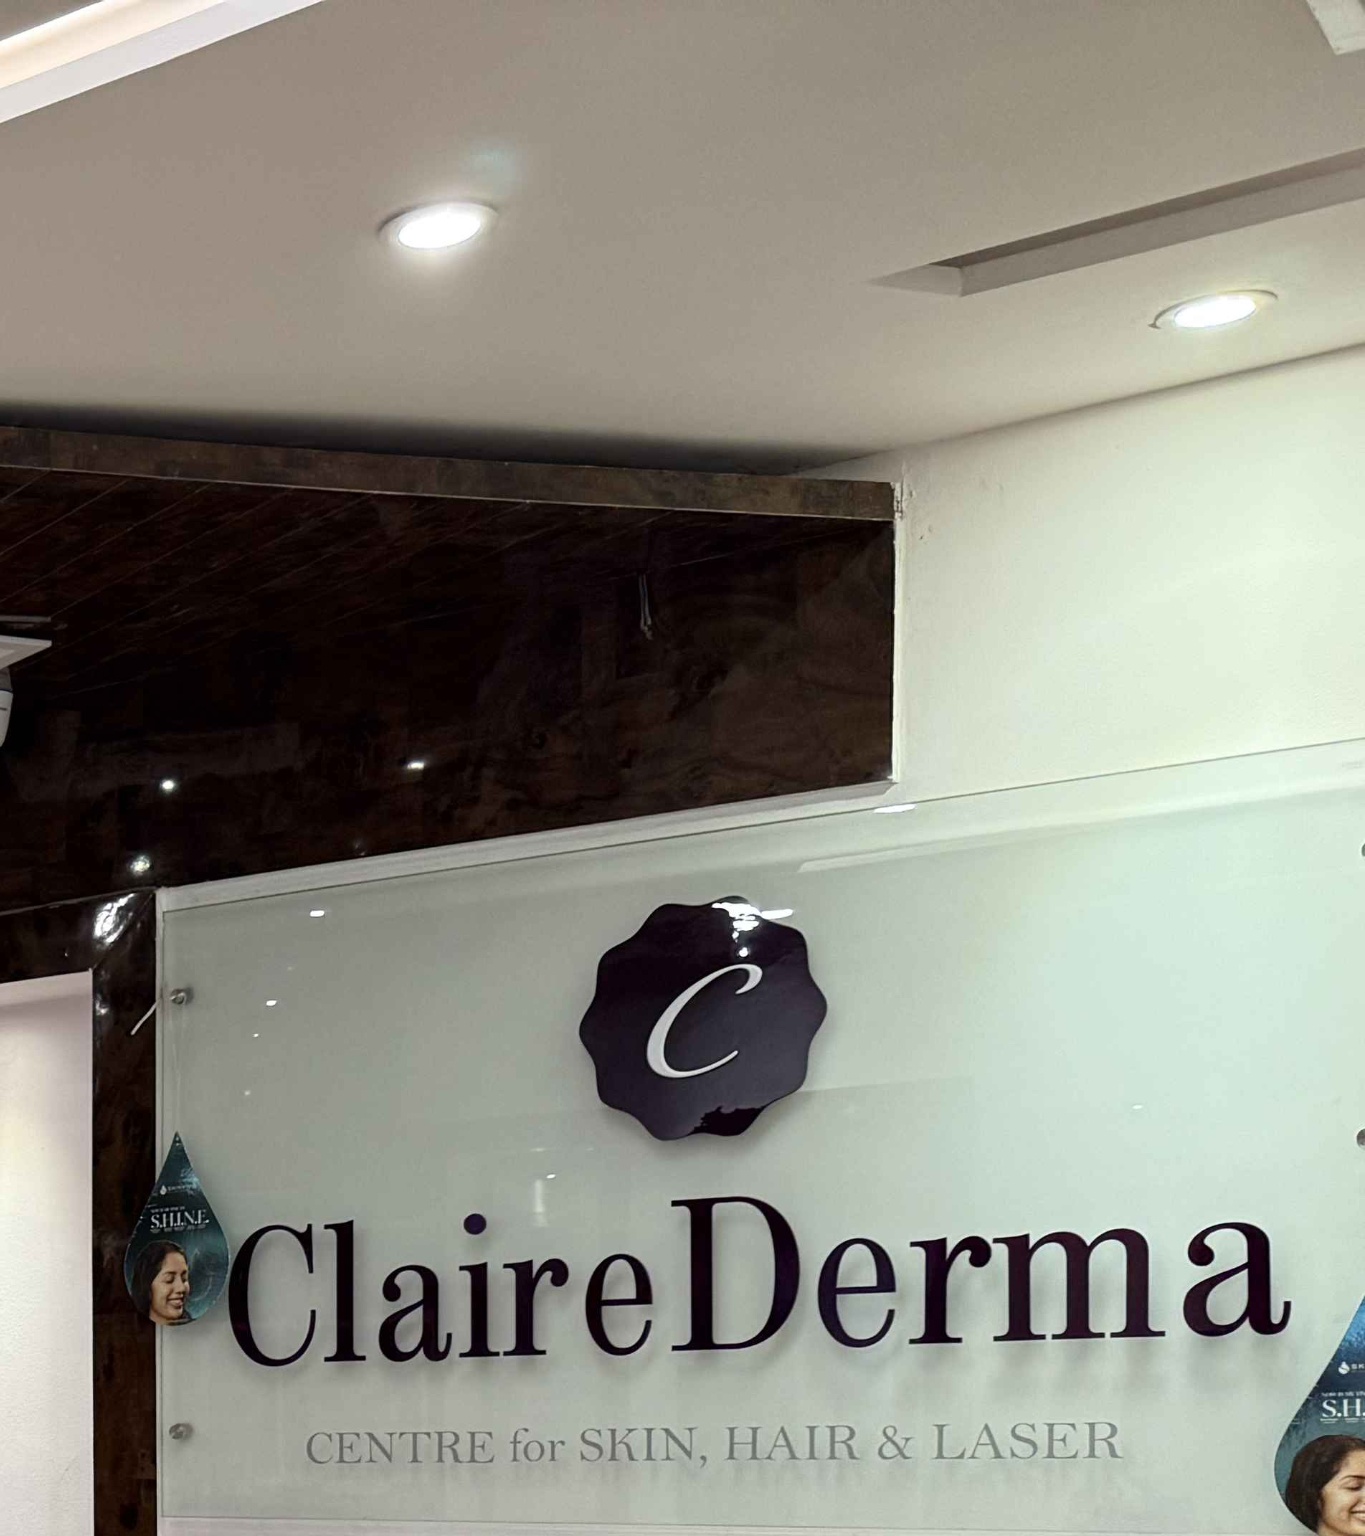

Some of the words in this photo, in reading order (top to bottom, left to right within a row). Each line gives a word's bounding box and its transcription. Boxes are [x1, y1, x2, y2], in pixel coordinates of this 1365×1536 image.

[226, 1195, 1292, 1370] ClaireDerma
[305, 1429, 495, 1466] CENTRE
[509, 1425, 566, 1464] for
[578, 1426, 709, 1470] SKIN,
[725, 1423, 860, 1464] HAIR
[876, 1423, 916, 1462] &
[931, 1420, 1124, 1462] LASER
